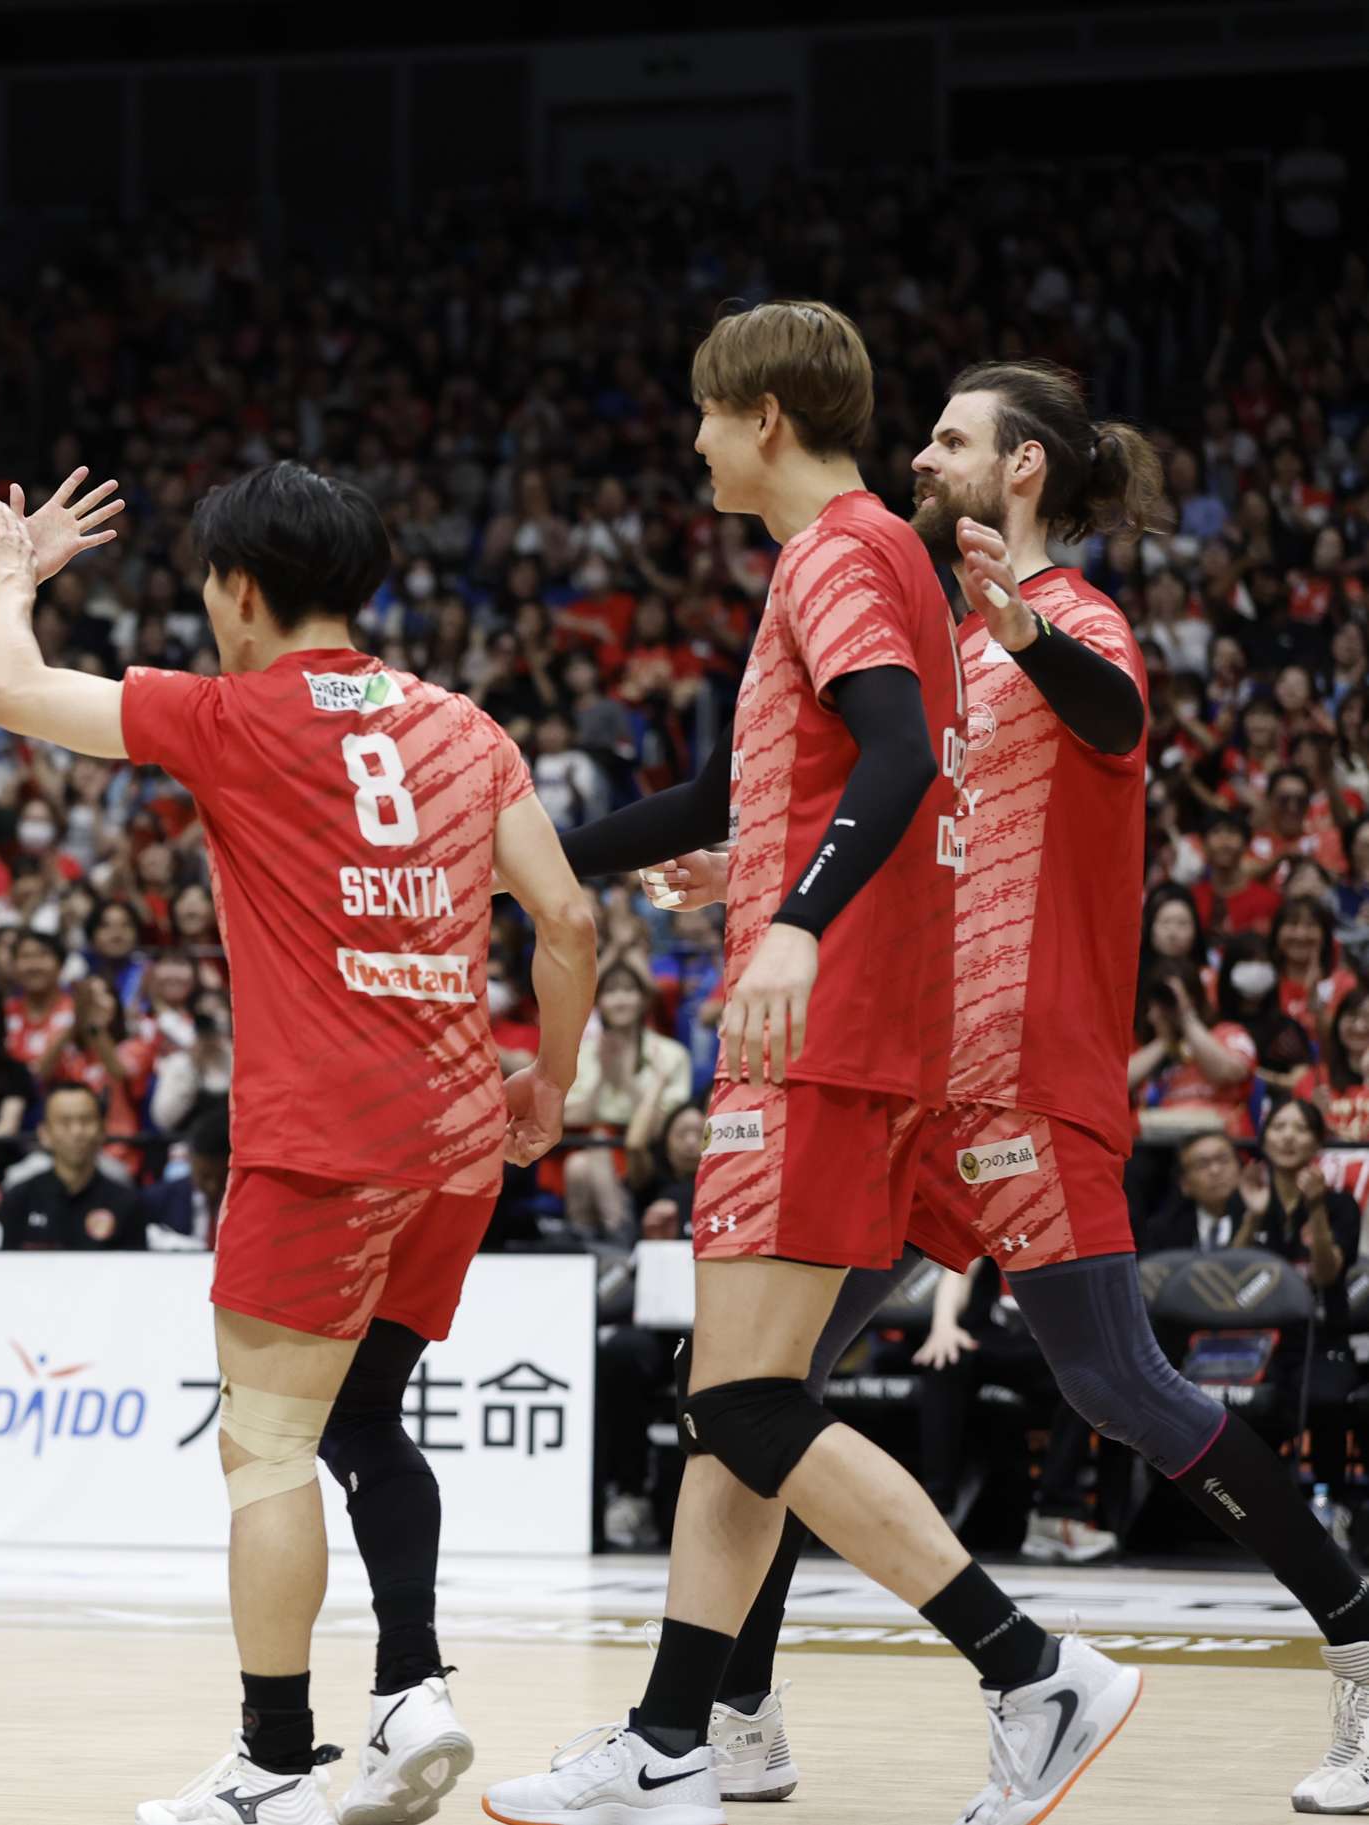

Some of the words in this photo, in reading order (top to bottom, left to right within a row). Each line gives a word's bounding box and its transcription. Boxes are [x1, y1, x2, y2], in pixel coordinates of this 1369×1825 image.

[311, 679, 361, 697] GREEN
[341, 732, 419, 846] 8
[339, 866, 454, 917] SEKITA
[713, 1123, 760, 1141] つの食品
[979, 1147, 1033, 1169] つの食品
